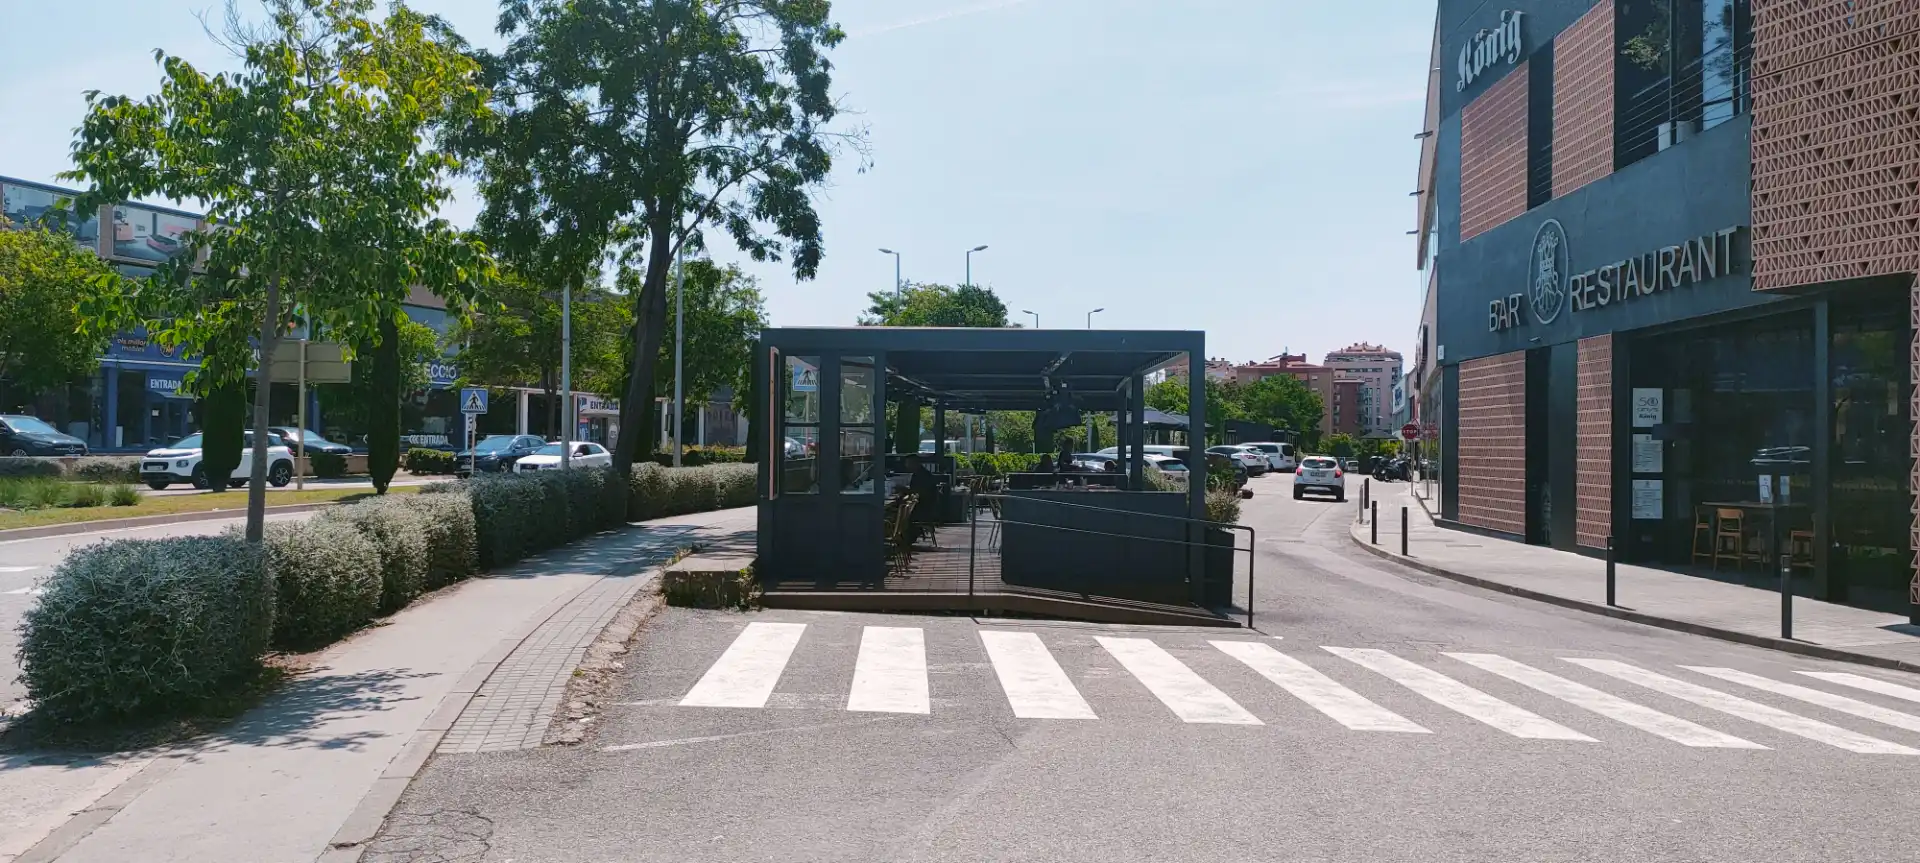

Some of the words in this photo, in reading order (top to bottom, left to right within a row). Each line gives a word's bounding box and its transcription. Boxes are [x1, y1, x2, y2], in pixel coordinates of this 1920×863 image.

[1456, 9, 1523, 92] König
[1488, 293, 1523, 333] BAR
[1569, 226, 1738, 313] RESTAURANT
[420, 434, 448, 445] ENTRADA
